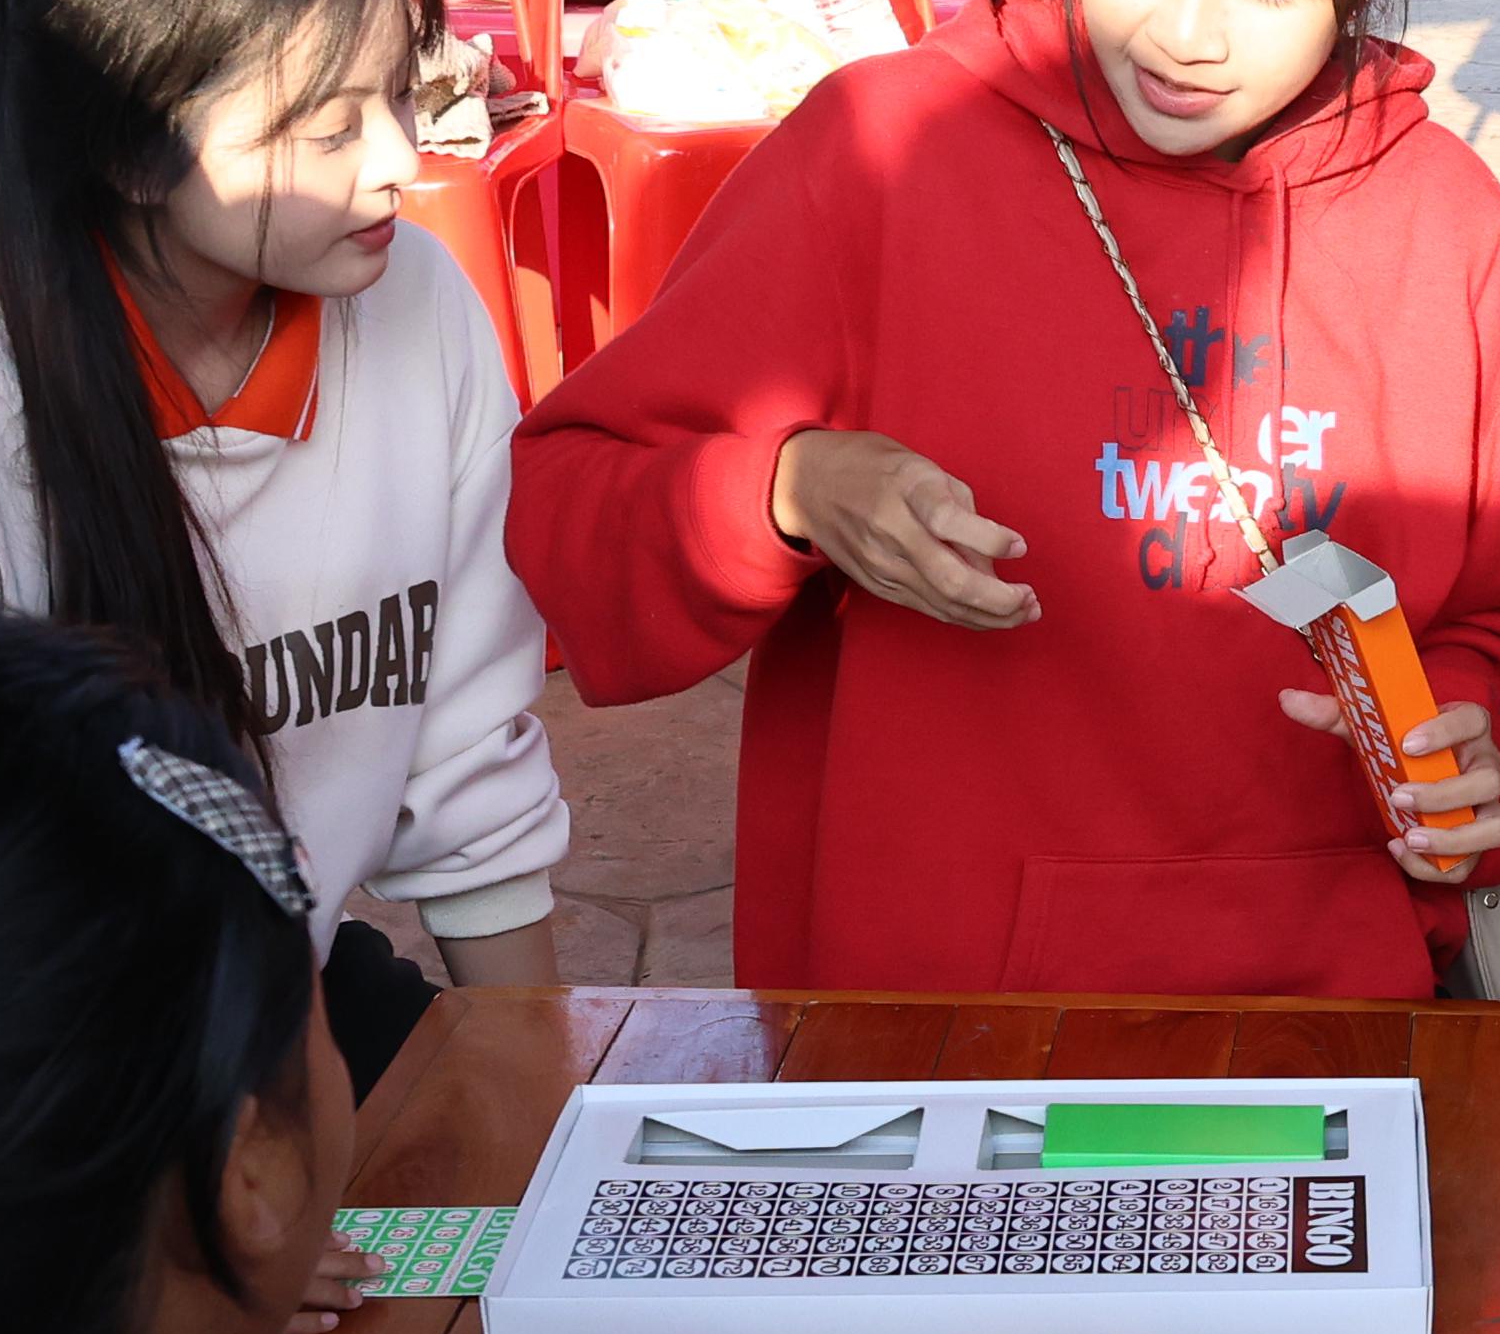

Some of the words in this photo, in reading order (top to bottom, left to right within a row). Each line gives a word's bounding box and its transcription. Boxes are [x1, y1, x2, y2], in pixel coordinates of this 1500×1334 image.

[1329, 615, 1398, 769] SHAKER
[458, 1210, 517, 1289] BINGO
[1305, 1181, 1355, 1266] BINGO
